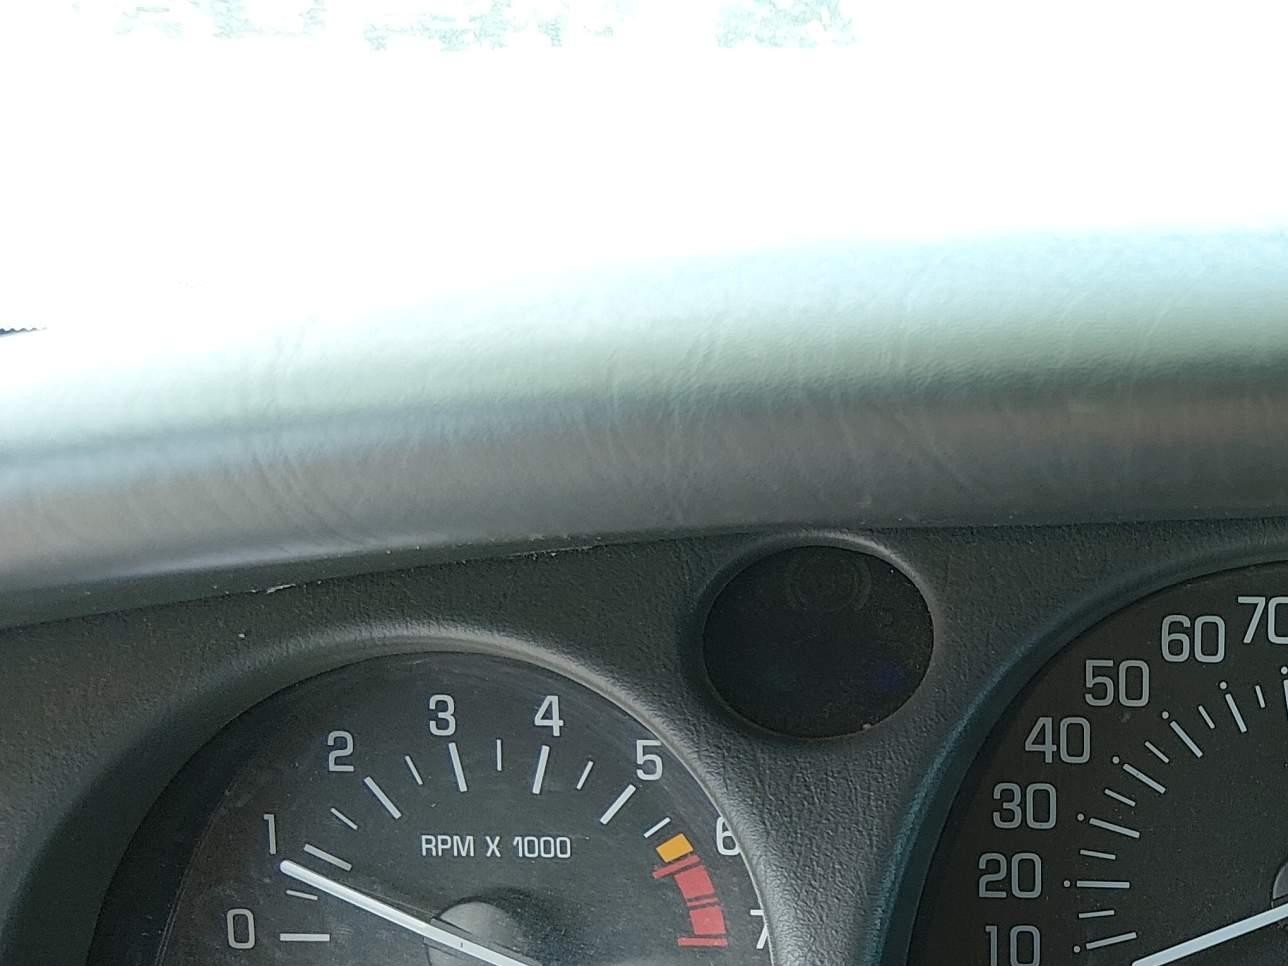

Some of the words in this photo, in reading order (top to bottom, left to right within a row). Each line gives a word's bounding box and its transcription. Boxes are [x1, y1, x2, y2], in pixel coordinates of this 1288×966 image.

[1161, 614, 1226, 663] 60
[1084, 659, 1150, 707] 50
[428, 694, 457, 736] 3
[534, 695, 564, 736] 4
[327, 731, 354, 772] 2
[635, 739, 663, 781] 5
[1024, 716, 1091, 764] 40
[992, 783, 1057, 829] 30
[263, 813, 276, 855] 1
[421, 834, 475, 857] RPM
[485, 834, 500, 857] X
[512, 836, 571, 858] 1000
[715, 817, 741, 856] 6
[978, 853, 1042, 898] 20
[226, 908, 256, 949] 0
